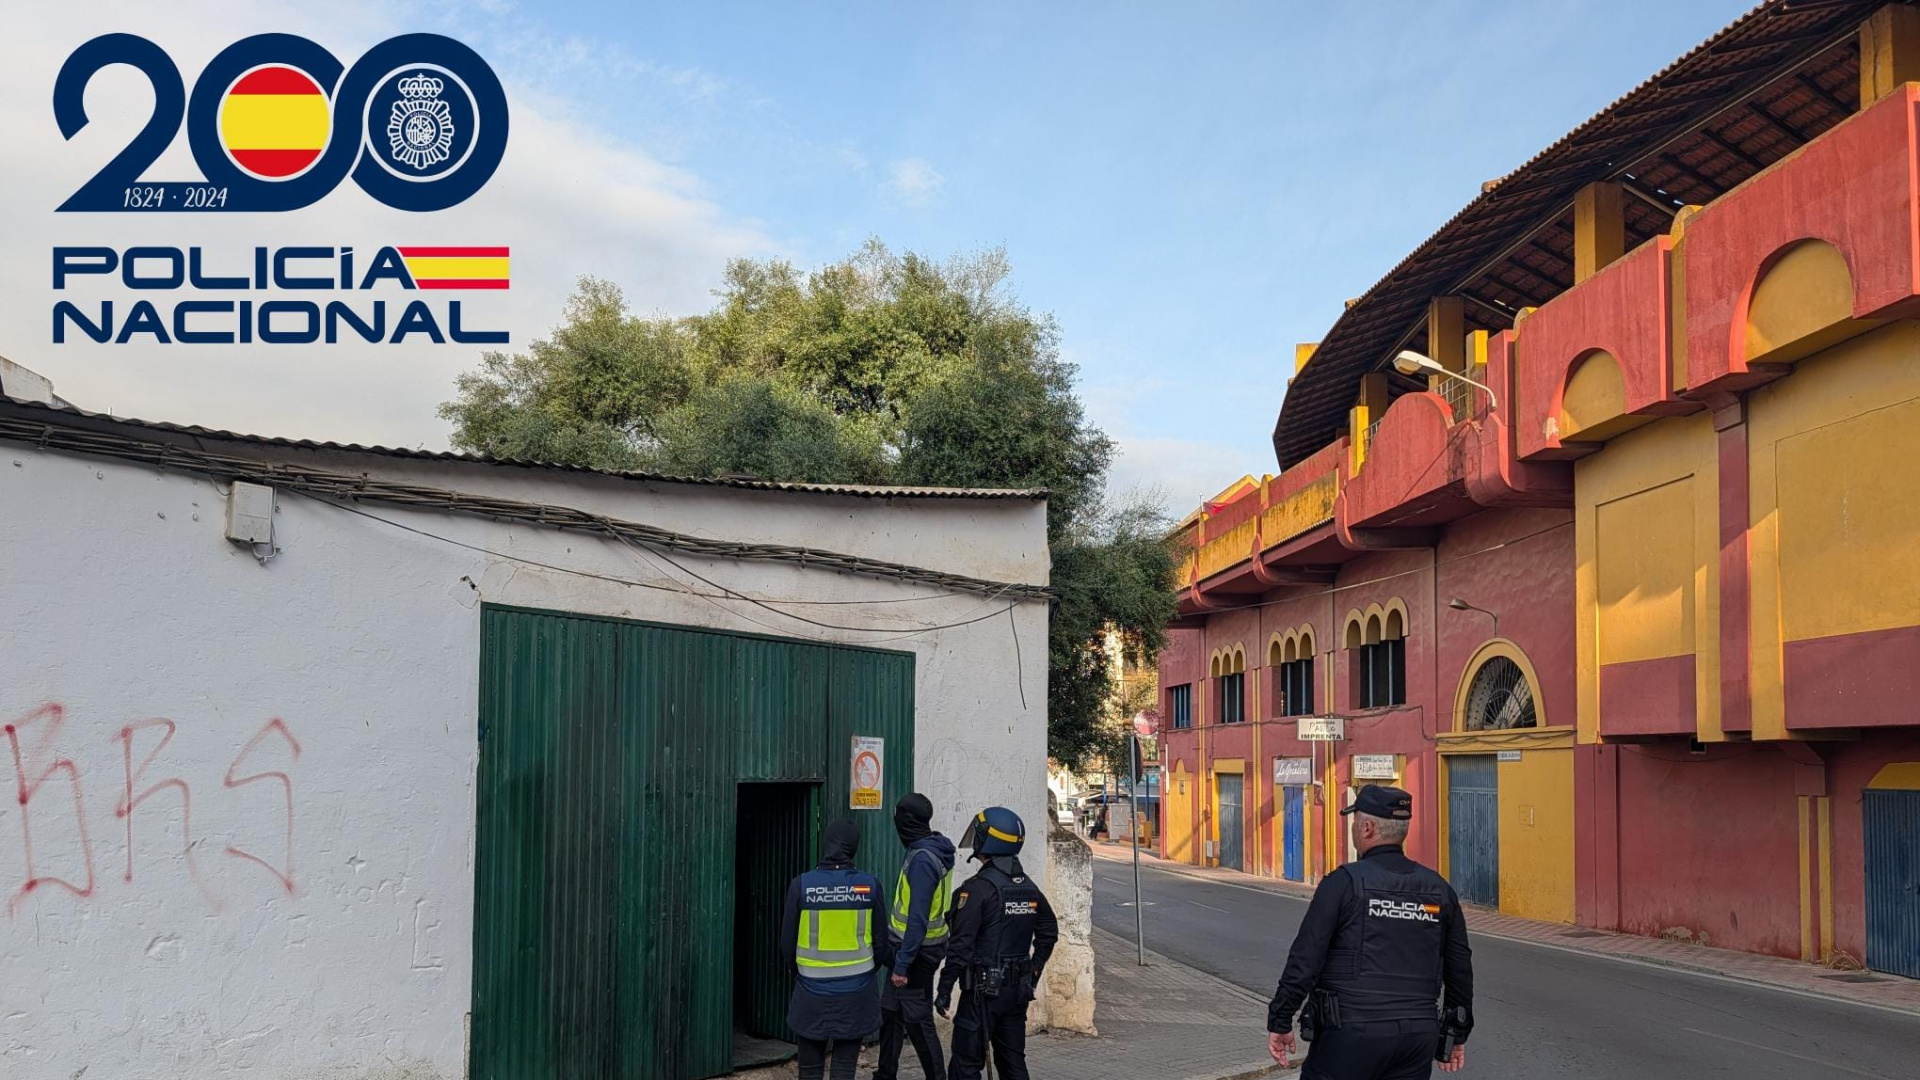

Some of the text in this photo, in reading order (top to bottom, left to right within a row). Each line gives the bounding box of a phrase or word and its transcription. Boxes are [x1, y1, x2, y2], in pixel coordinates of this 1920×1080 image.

[806, 885, 855, 895] POLICIA
[806, 894, 871, 903] NACIONAL
[1369, 899, 1426, 912] POLICIA
[1369, 909, 1439, 923] NACIONAL
